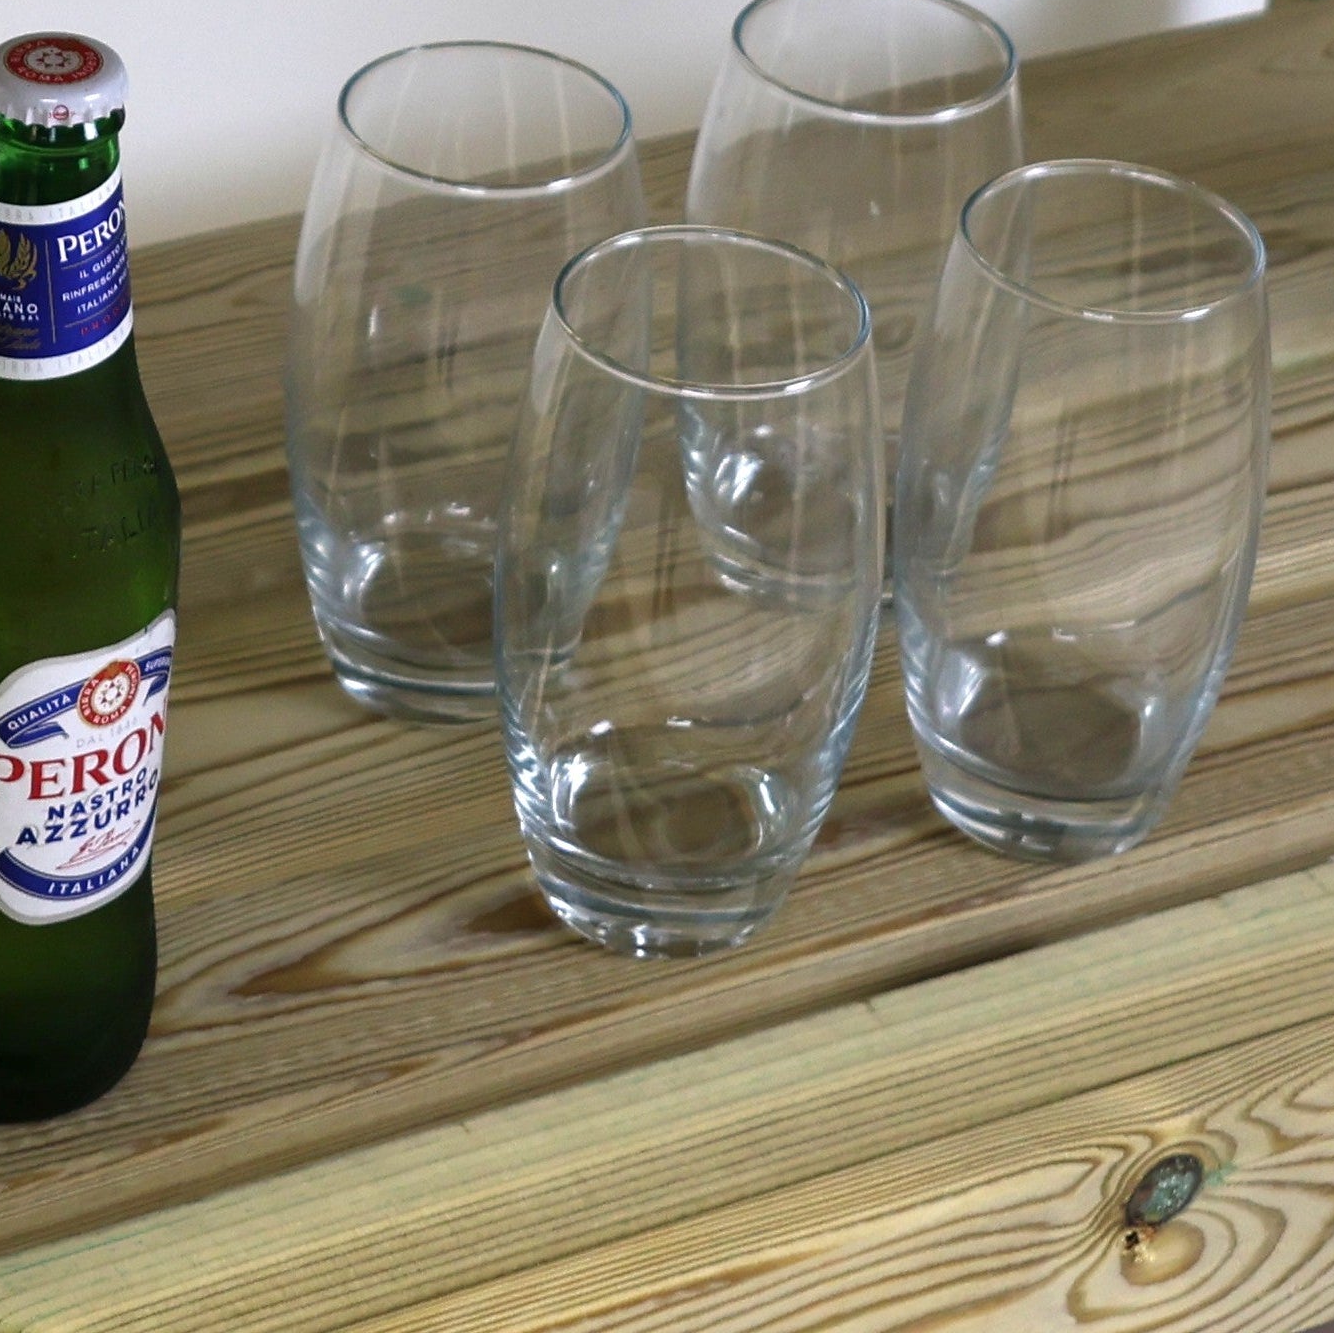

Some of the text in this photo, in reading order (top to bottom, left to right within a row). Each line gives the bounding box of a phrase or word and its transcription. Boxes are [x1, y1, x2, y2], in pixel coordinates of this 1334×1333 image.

[79, 244, 121, 279] IL GUSTO
[0, 293, 21, 303] MAIS
[77, 284, 119, 315] ITALIANA
[81, 678, 100, 716] BIRRA
[92, 705, 127, 724] ROMA
[15, 768, 159, 846] AZZURRO
[47, 767, 148, 823] NASTRO
[47, 846, 140, 894] ITALIANA
